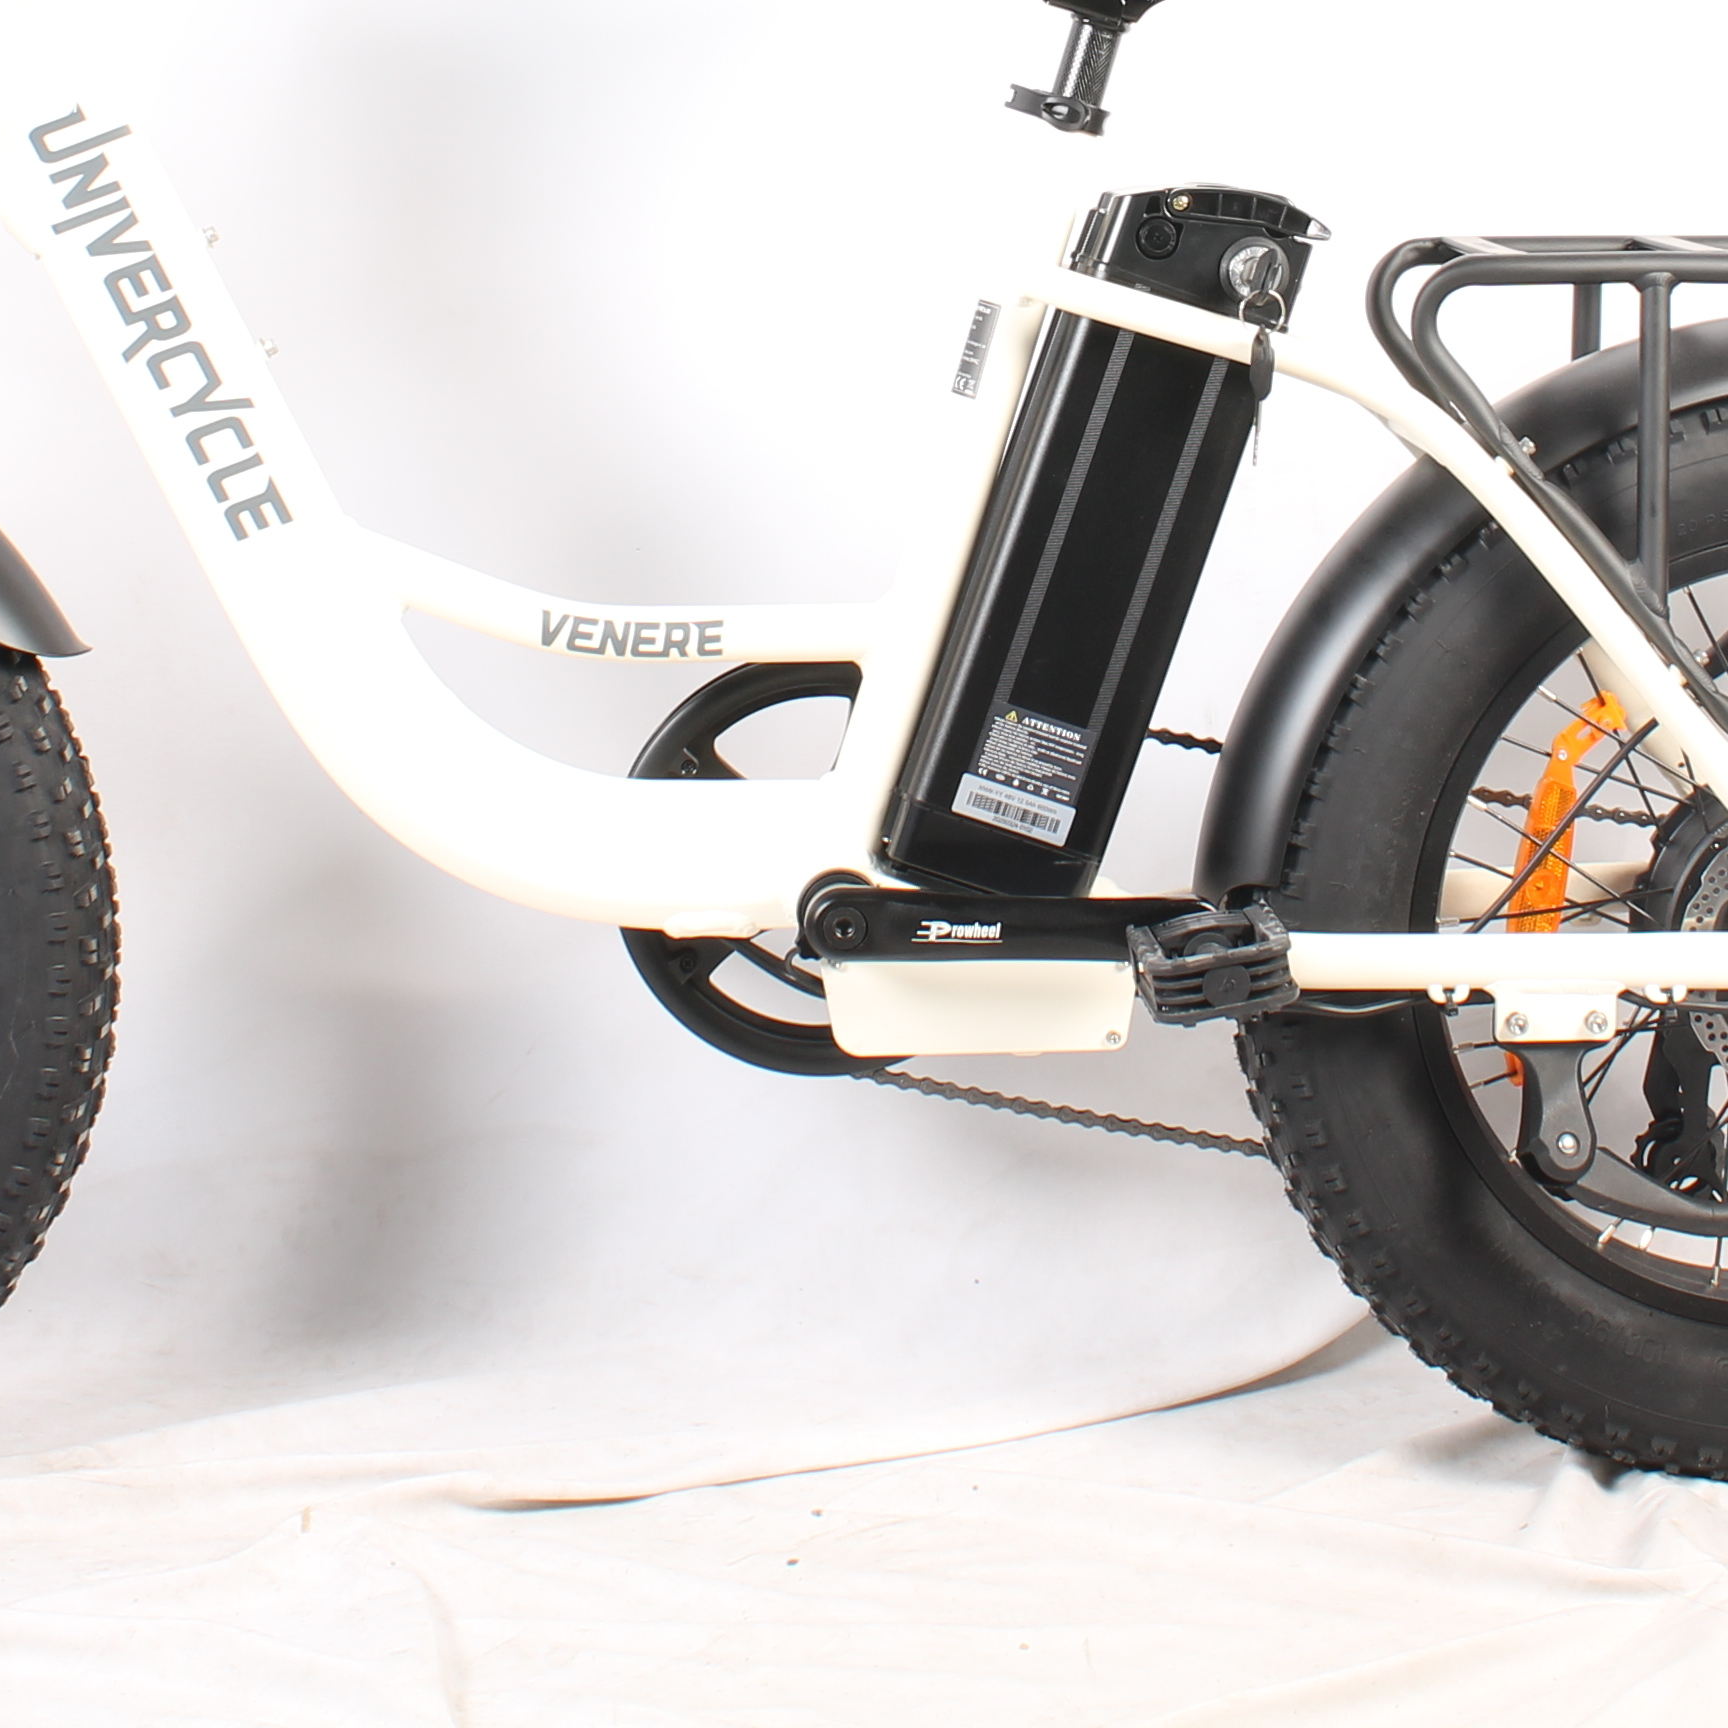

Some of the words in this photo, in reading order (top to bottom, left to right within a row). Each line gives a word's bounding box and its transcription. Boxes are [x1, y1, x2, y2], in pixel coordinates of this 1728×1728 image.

[28, 103, 293, 541] UNIVERCYCLE
[541, 610, 724, 658] VENERE
[1022, 717, 1081, 741] ATTENTION
[917, 920, 1002, 942] Prowheel
